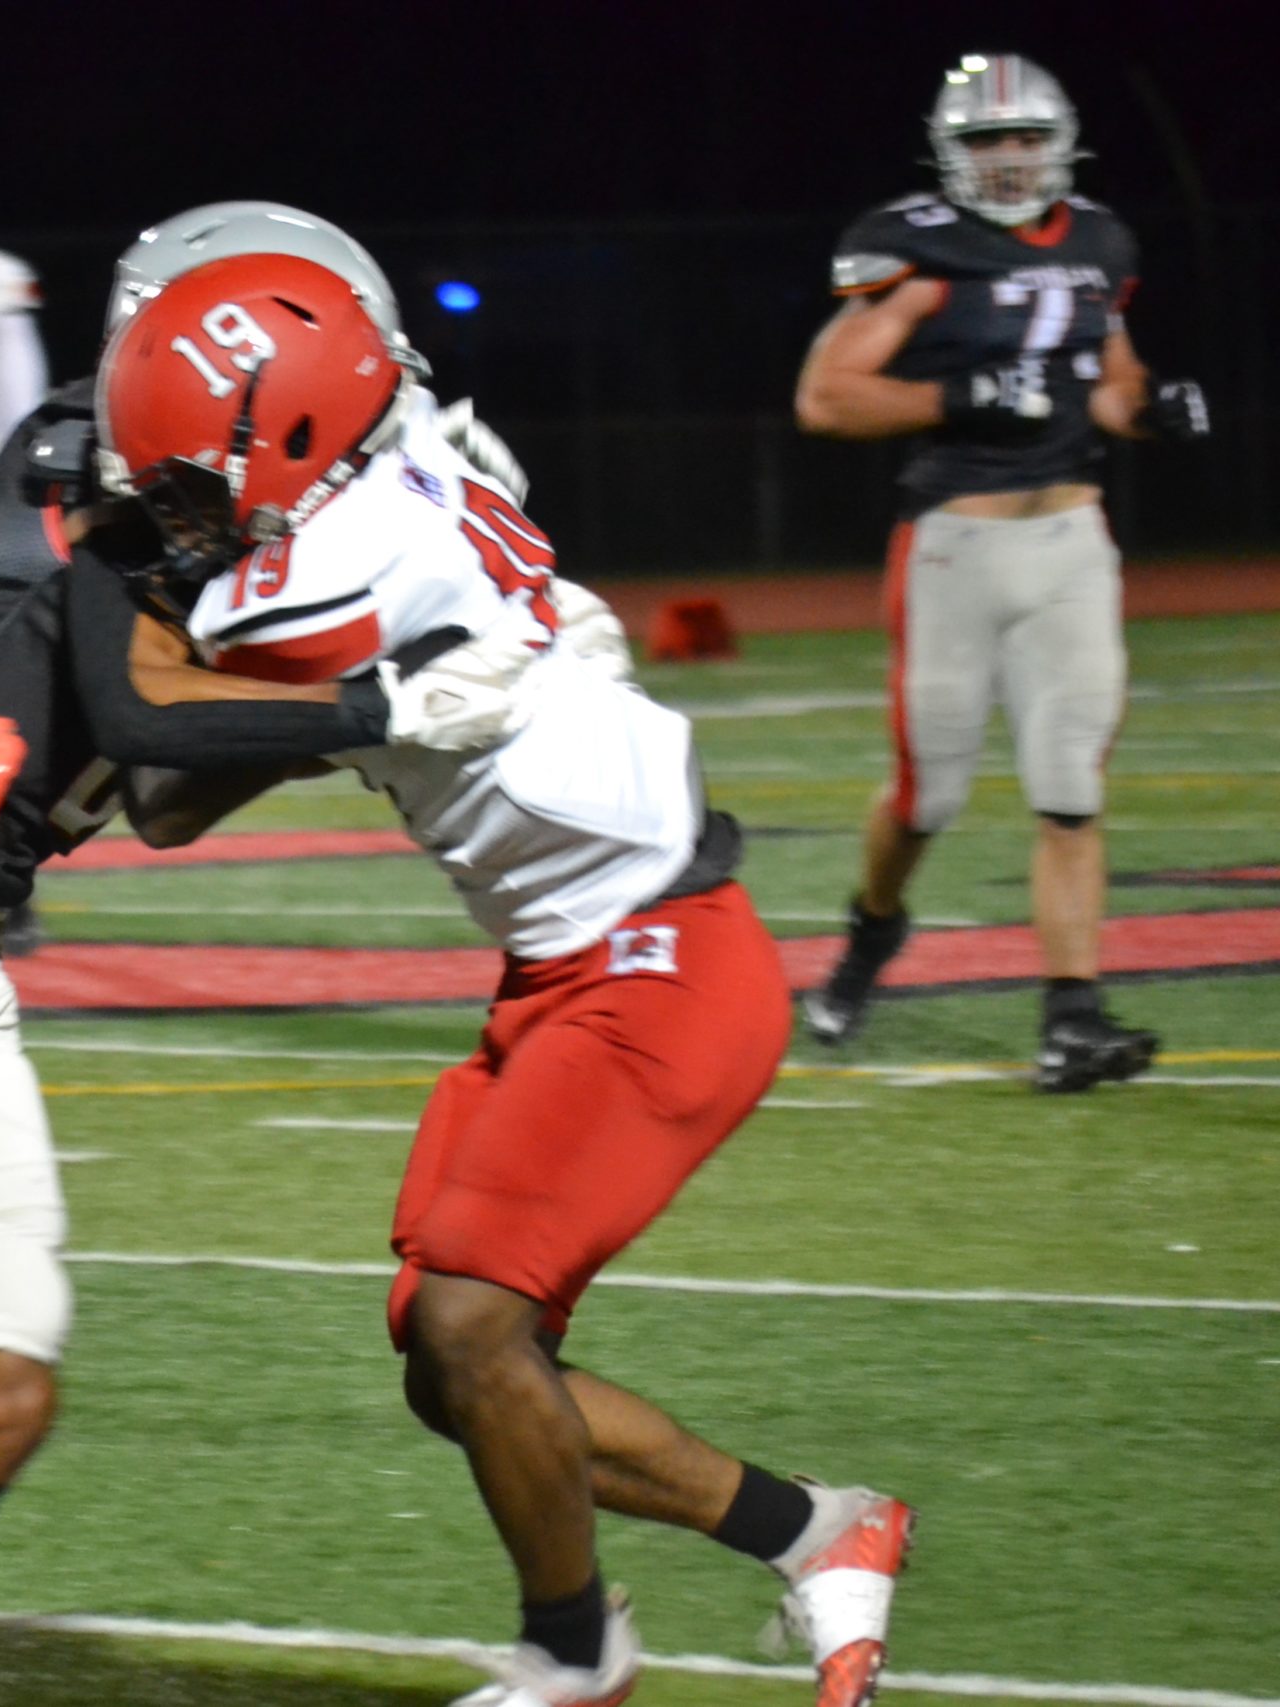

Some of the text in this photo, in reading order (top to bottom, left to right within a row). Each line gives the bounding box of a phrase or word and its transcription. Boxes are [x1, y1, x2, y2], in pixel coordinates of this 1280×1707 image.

[171, 303, 276, 398] 19
[992, 277, 1074, 352] 7
[230, 534, 297, 612] 19
